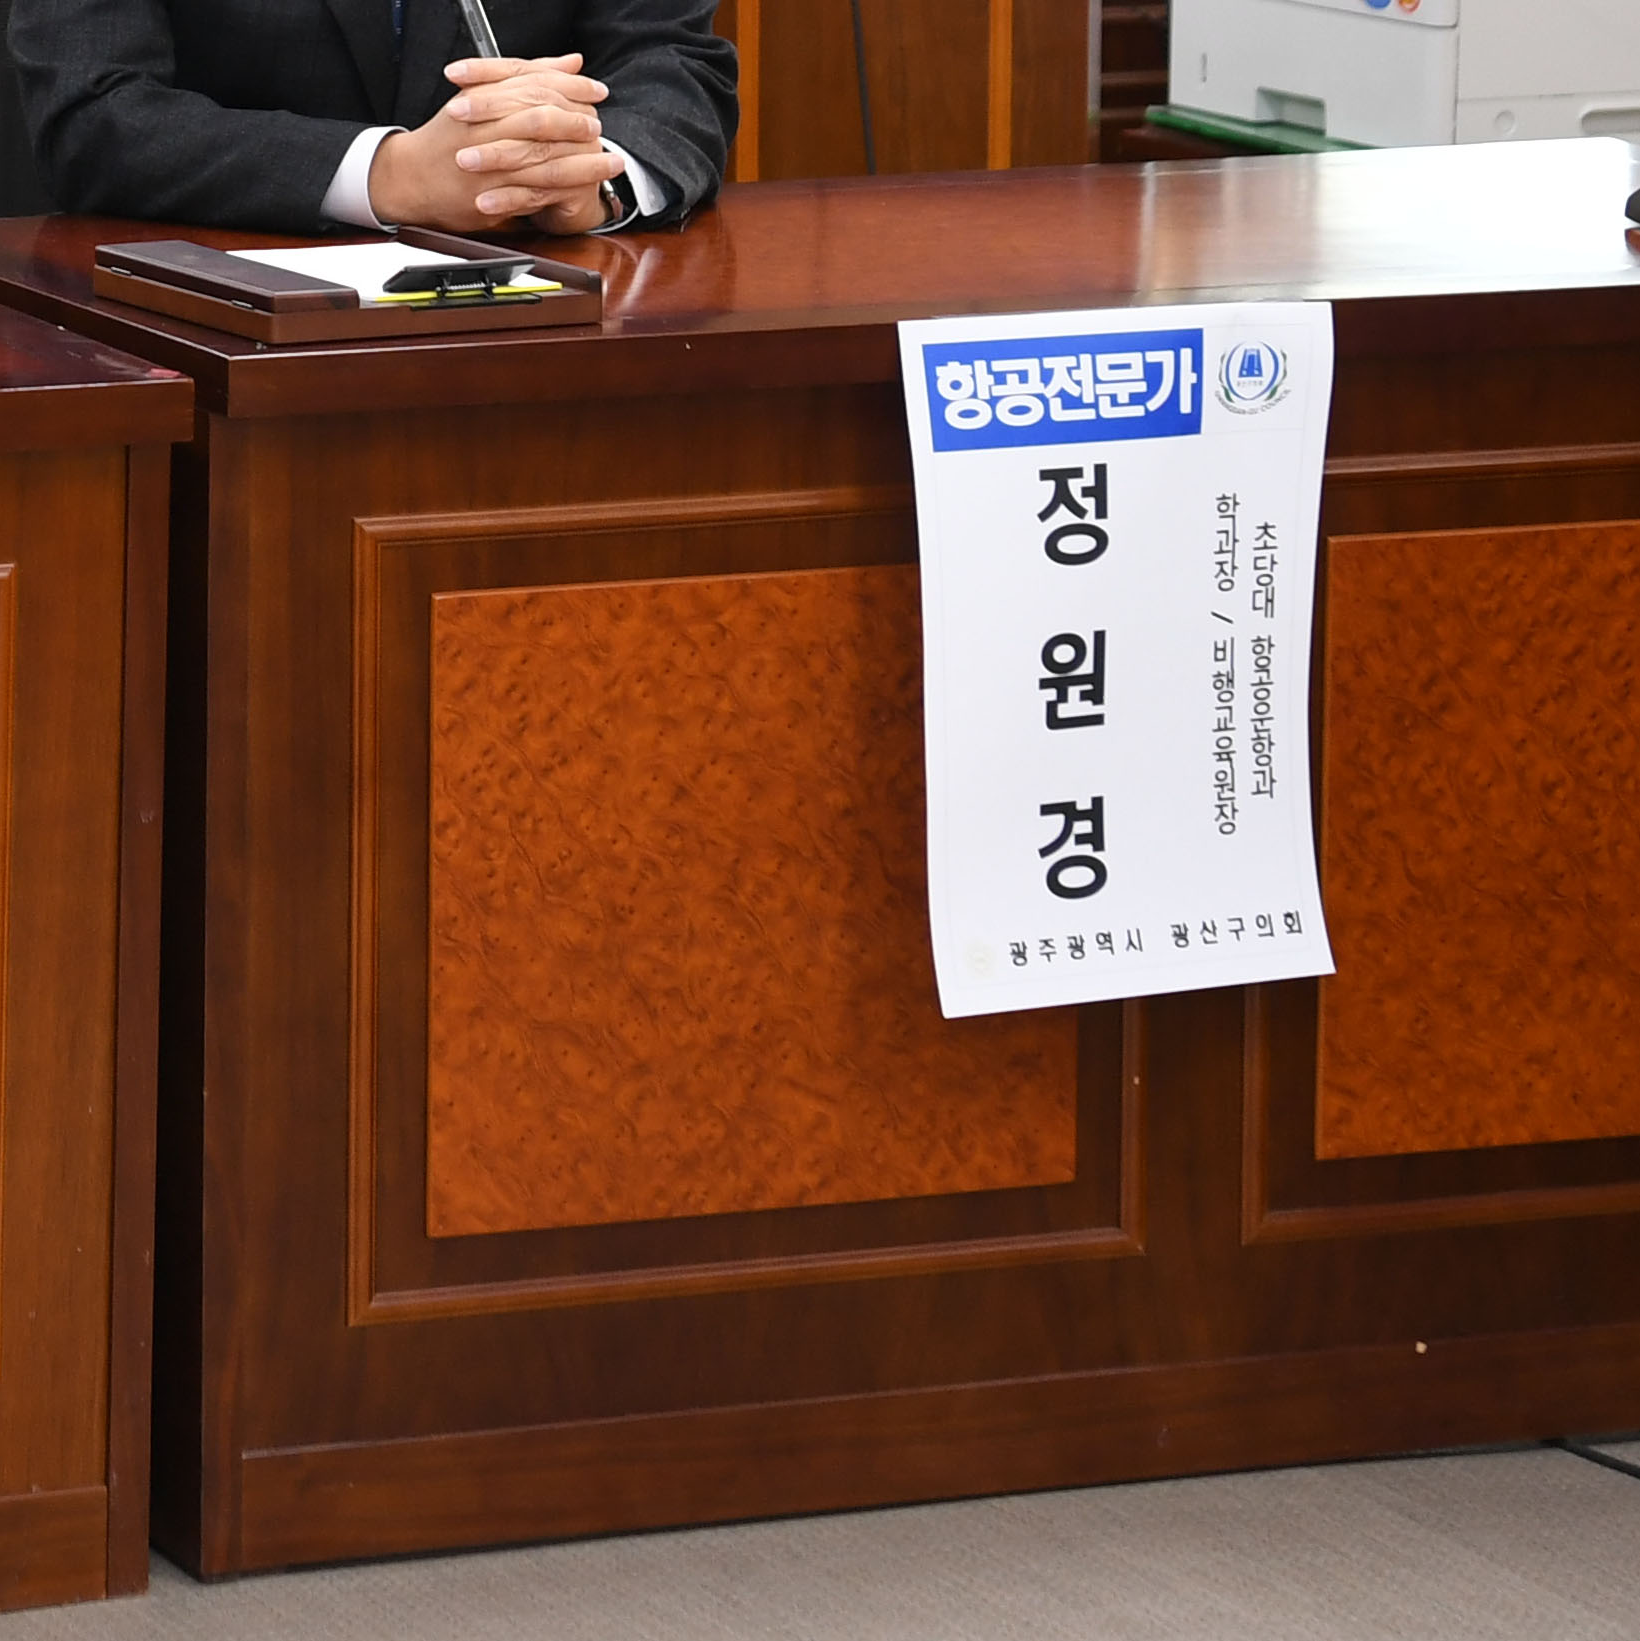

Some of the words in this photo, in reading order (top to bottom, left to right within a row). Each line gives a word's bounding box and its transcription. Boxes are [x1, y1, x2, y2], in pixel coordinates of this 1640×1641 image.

[935, 348, 1197, 429] 항공전문가
[1214, 493, 1240, 592] 학과장
[1252, 522, 1278, 618] 초당대
[1212, 637, 1239, 835] 비행교육원장
[1250, 635, 1277, 799] 항공운항과
[1010, 928, 1143, 966] 광주광역시
[1171, 911, 1302, 948] 광산구의회
